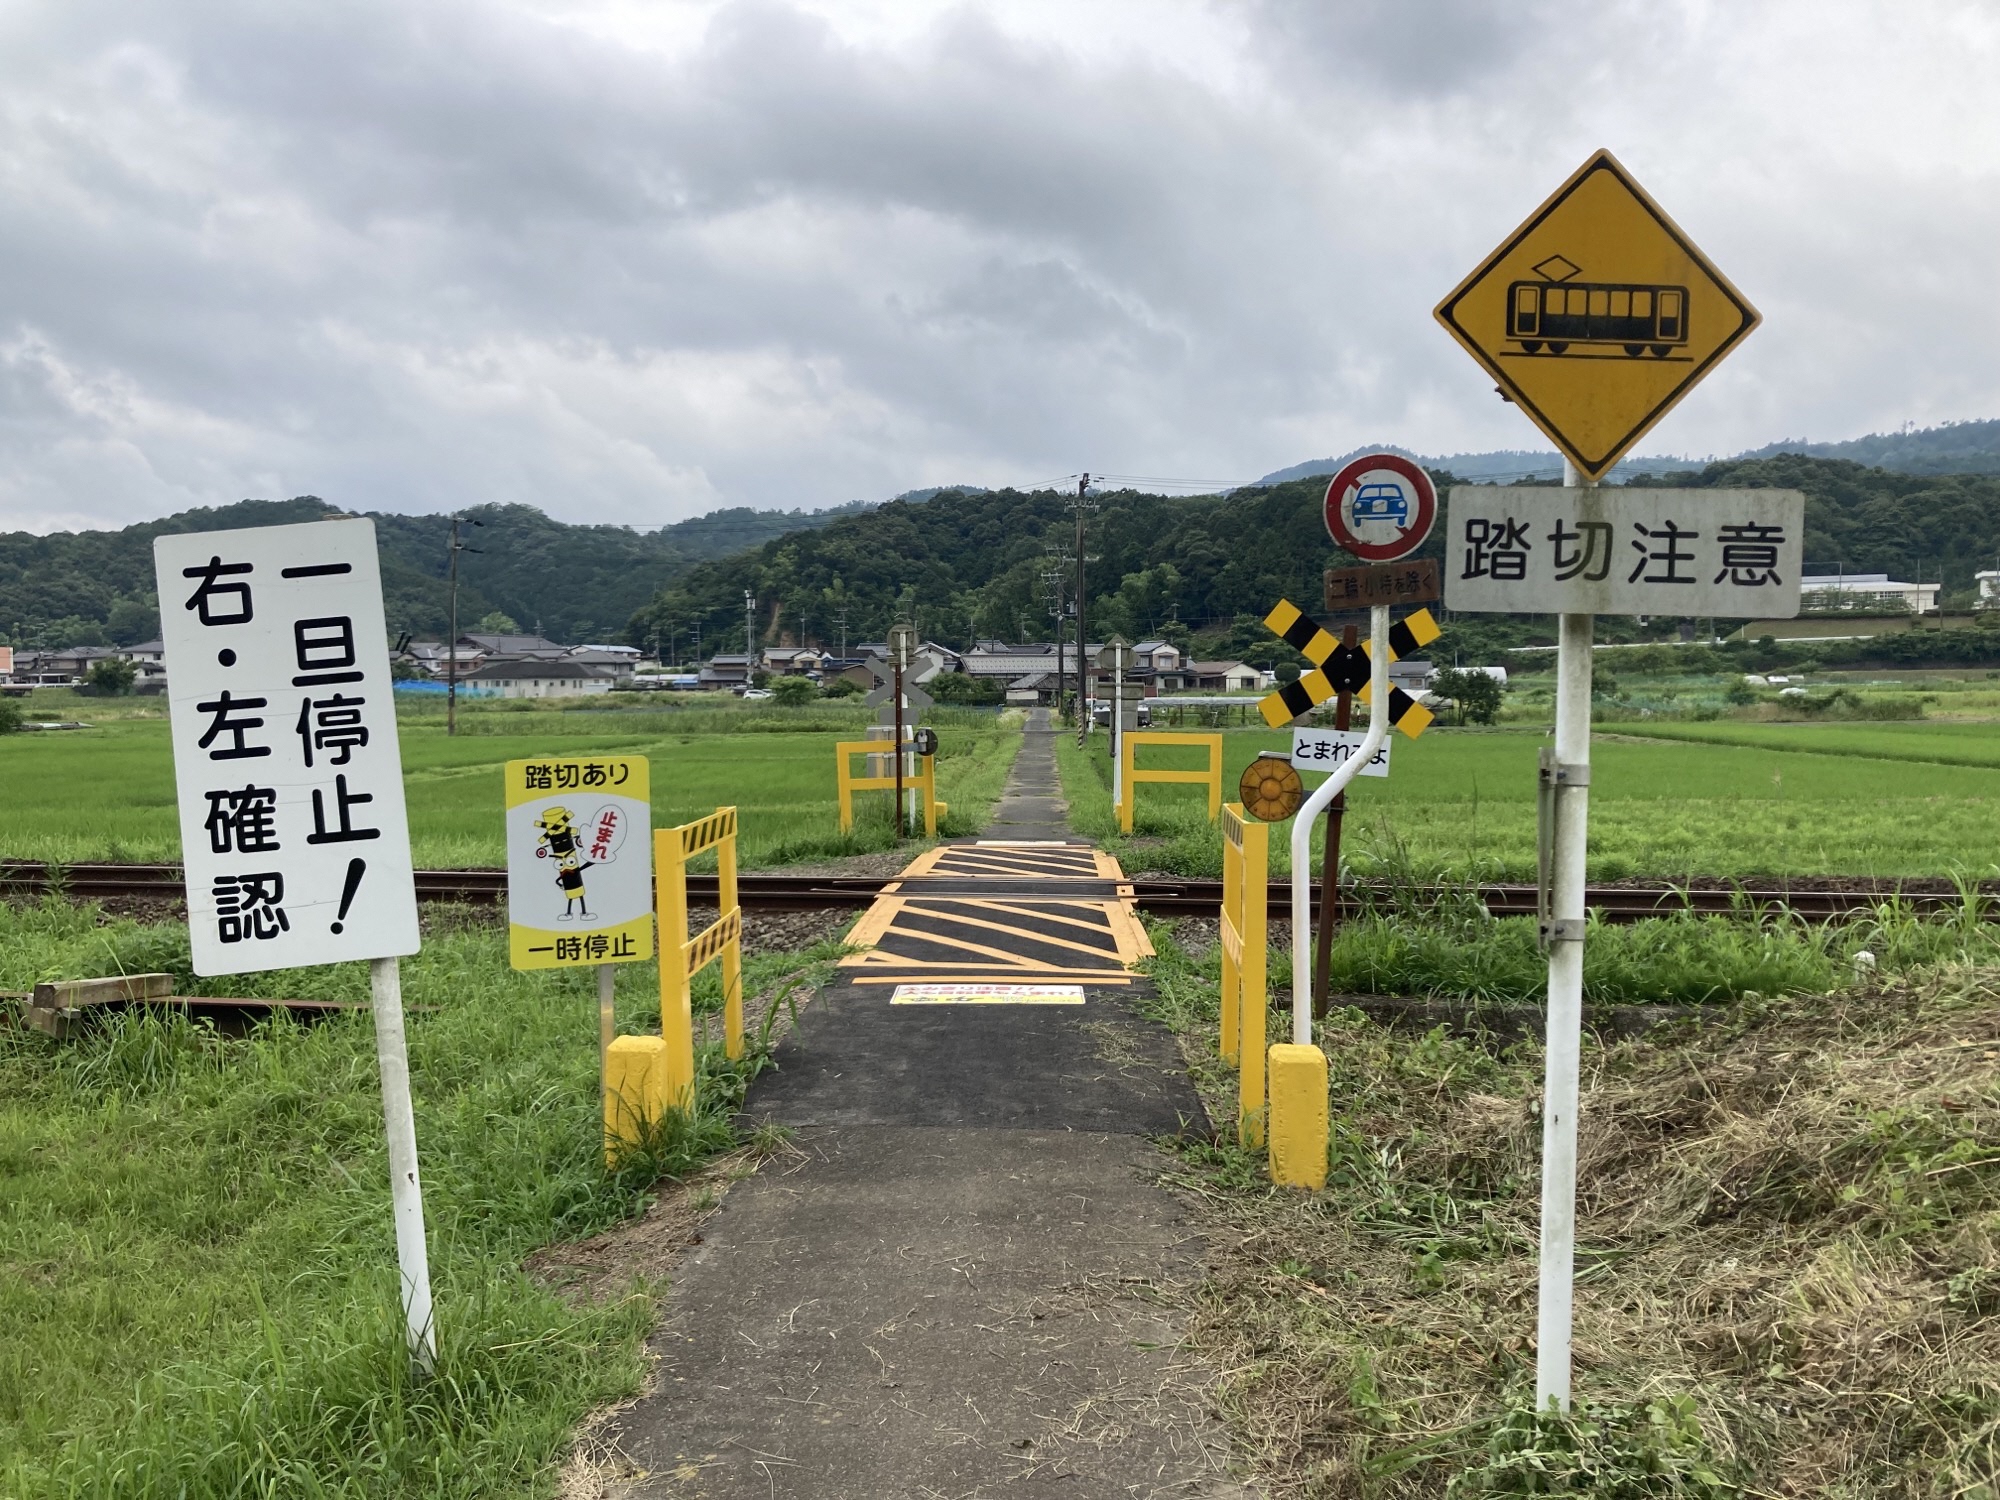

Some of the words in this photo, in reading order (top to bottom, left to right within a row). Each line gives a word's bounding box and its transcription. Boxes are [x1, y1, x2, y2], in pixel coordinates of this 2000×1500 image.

[1461, 517, 1786, 586] 踏切注意
[182, 555, 291, 944] 右・左確認
[281, 562, 381, 936] 一旦停止!
[1295, 738, 1387, 765] とまれよ
[525, 763, 629, 789] 踏切あり
[590, 811, 618, 860] 止まれ
[528, 932, 637, 961] 一時停止
